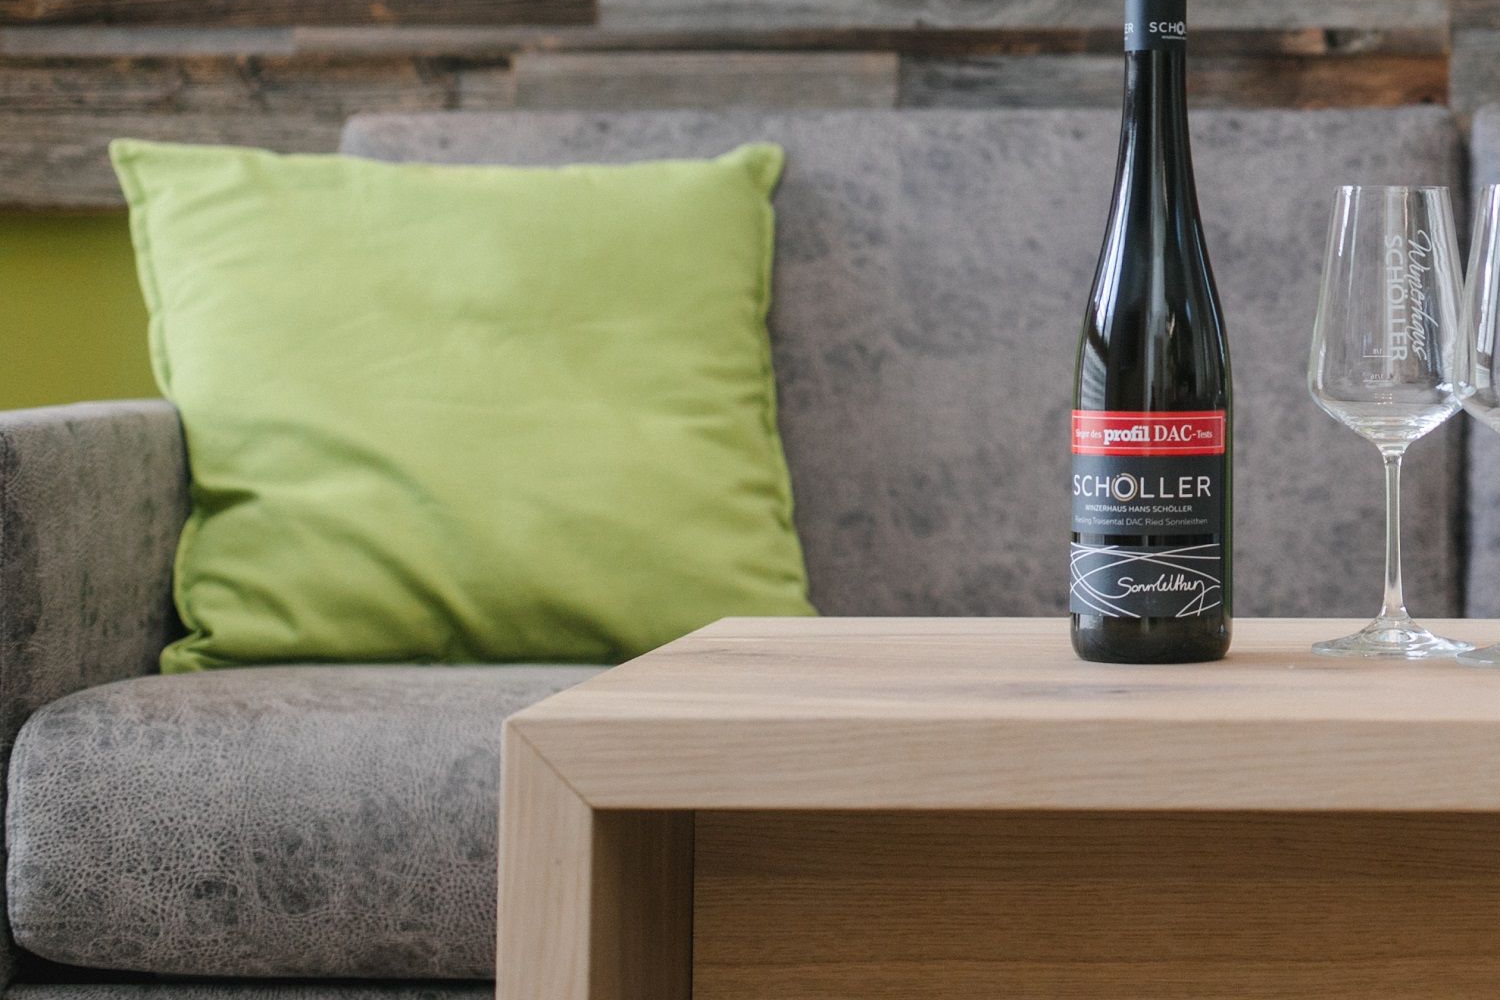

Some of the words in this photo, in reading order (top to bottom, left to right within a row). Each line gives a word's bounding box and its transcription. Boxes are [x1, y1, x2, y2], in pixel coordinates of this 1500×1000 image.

[1384, 234, 1408, 361] SCHÖLLER
[1404, 229, 1439, 361] Winzerhaus
[1103, 425, 1150, 445] profil
[1073, 473, 1212, 500] SCHÖLLER
[1085, 504, 1127, 513] WINZERHAUS
[1128, 505, 1151, 513] HANS
[1152, 504, 1193, 513] SCHÖLLER
[1125, 518, 1143, 526] DAC
[1145, 517, 1164, 526] Ried
